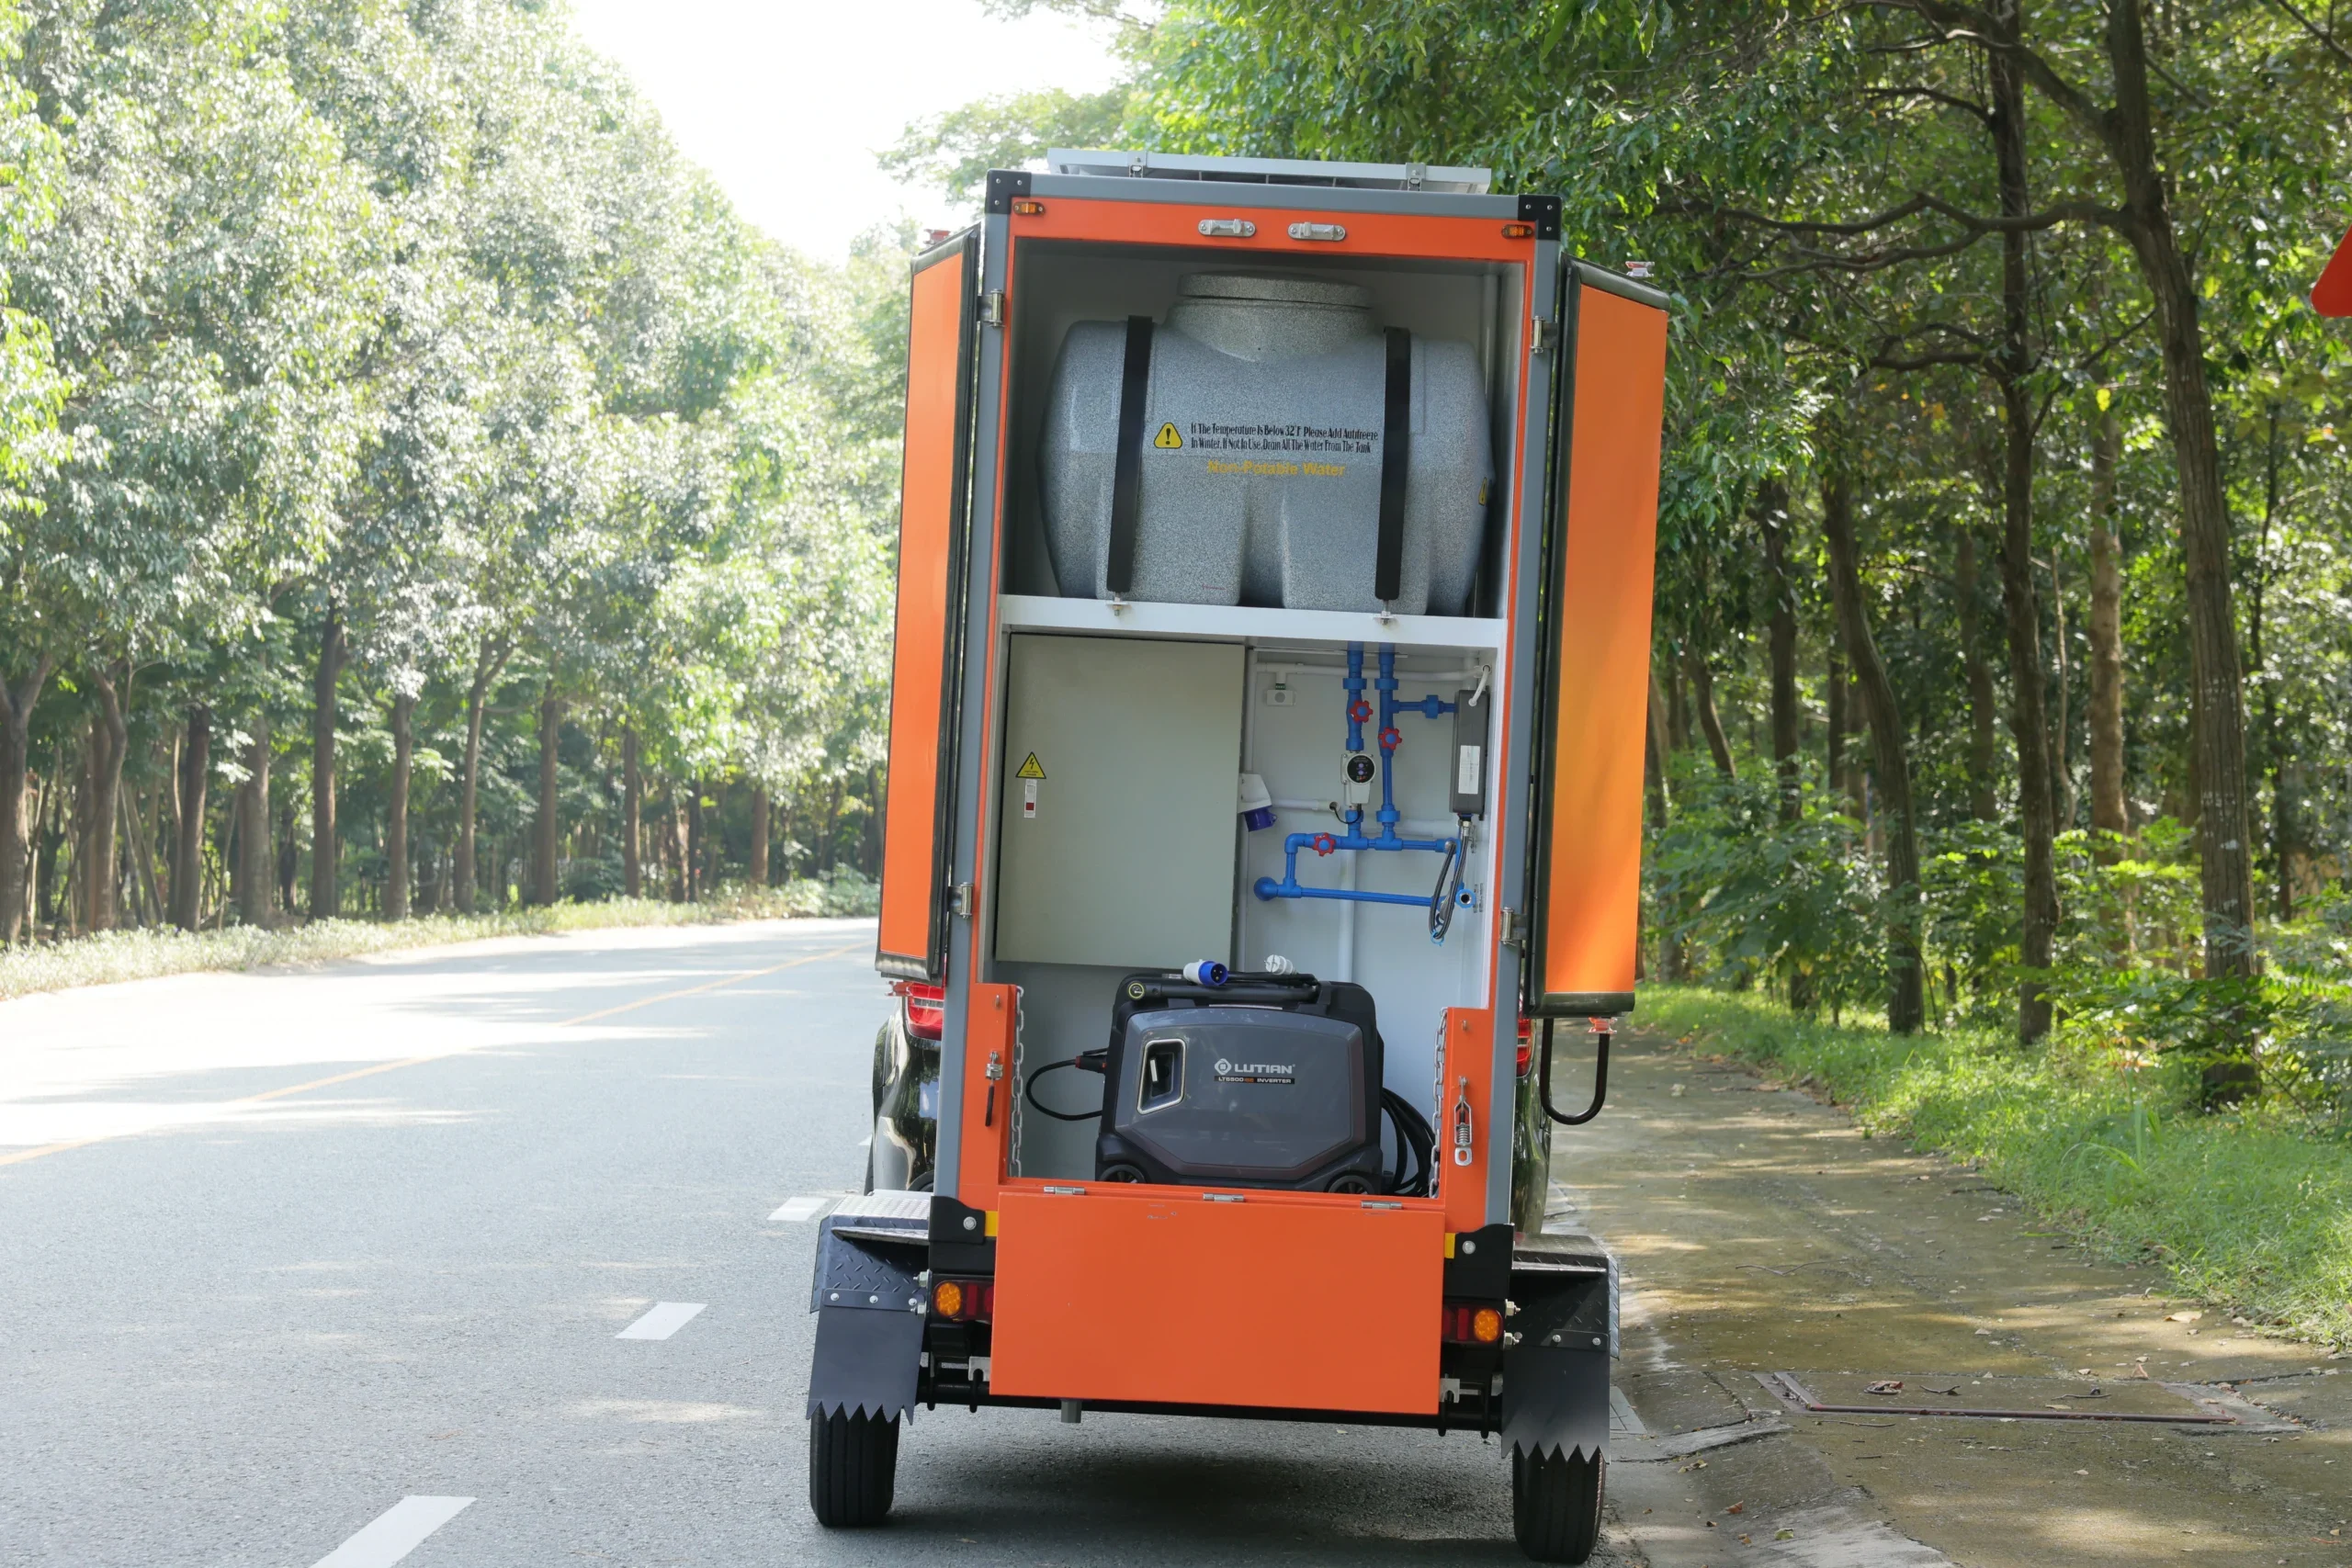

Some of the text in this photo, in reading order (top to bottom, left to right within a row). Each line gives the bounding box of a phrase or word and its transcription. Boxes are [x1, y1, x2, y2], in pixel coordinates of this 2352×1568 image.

[1191, 423, 1196, 434] If
[1198, 423, 1211, 435] The
[1212, 423, 1256, 437] Temperature
[1257, 424, 1263, 435] Is
[1264, 424, 1284, 435] Below
[1304, 426, 1328, 438] Please
[1328, 427, 1341, 439] Add
[1191, 437, 1198, 448] In
[1222, 437, 1227, 449] If
[1228, 438, 1240, 449] Not
[1263, 438, 1281, 450] Drain
[1283, 439, 1291, 451] All
[1292, 439, 1303, 451] The
[1304, 439, 1323, 452] Water
[1325, 440, 1341, 452] From
[1341, 440, 1354, 452] The
[1355, 441, 1371, 454] Tank
[1207, 459, 1346, 477] Non-Potable Water
[1234, 1063, 1293, 1074] LUTIAN
